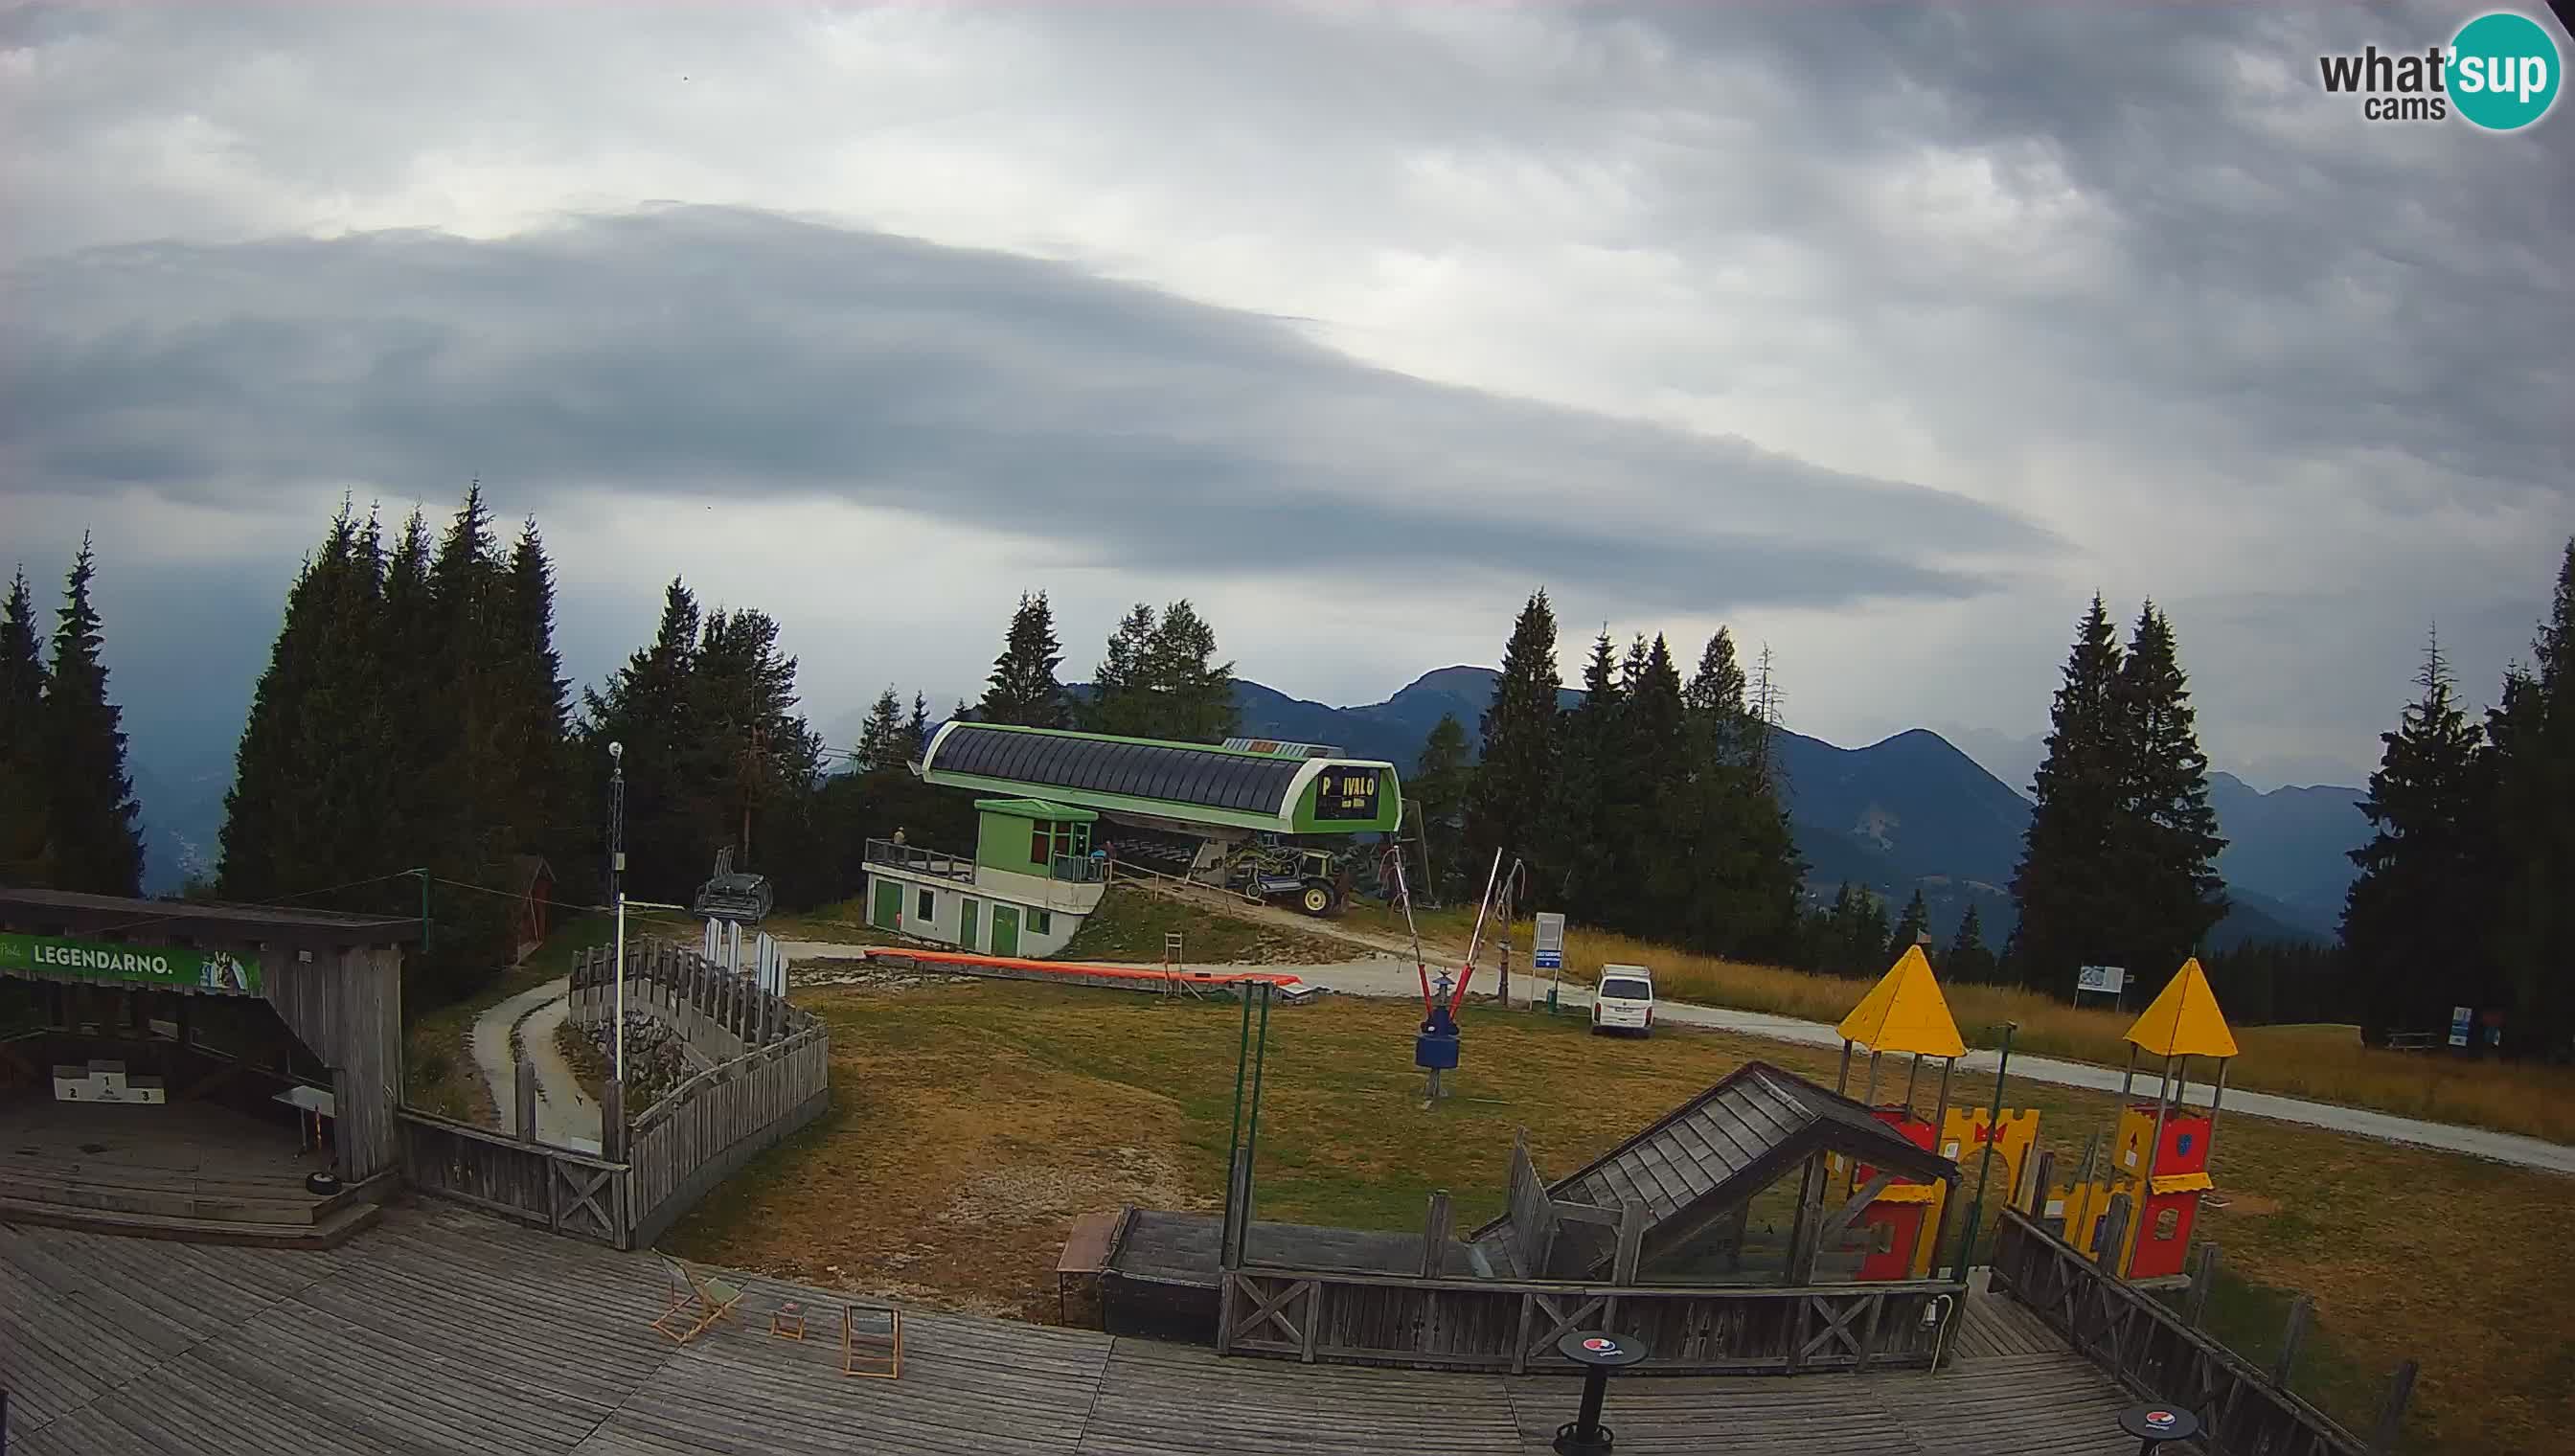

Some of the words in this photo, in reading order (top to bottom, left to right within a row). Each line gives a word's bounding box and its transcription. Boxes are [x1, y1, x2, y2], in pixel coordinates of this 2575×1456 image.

[34, 944, 173, 975] LEGENDARNO.
[69, 1087, 78, 1099] 2
[142, 1090, 150, 1102] 3
